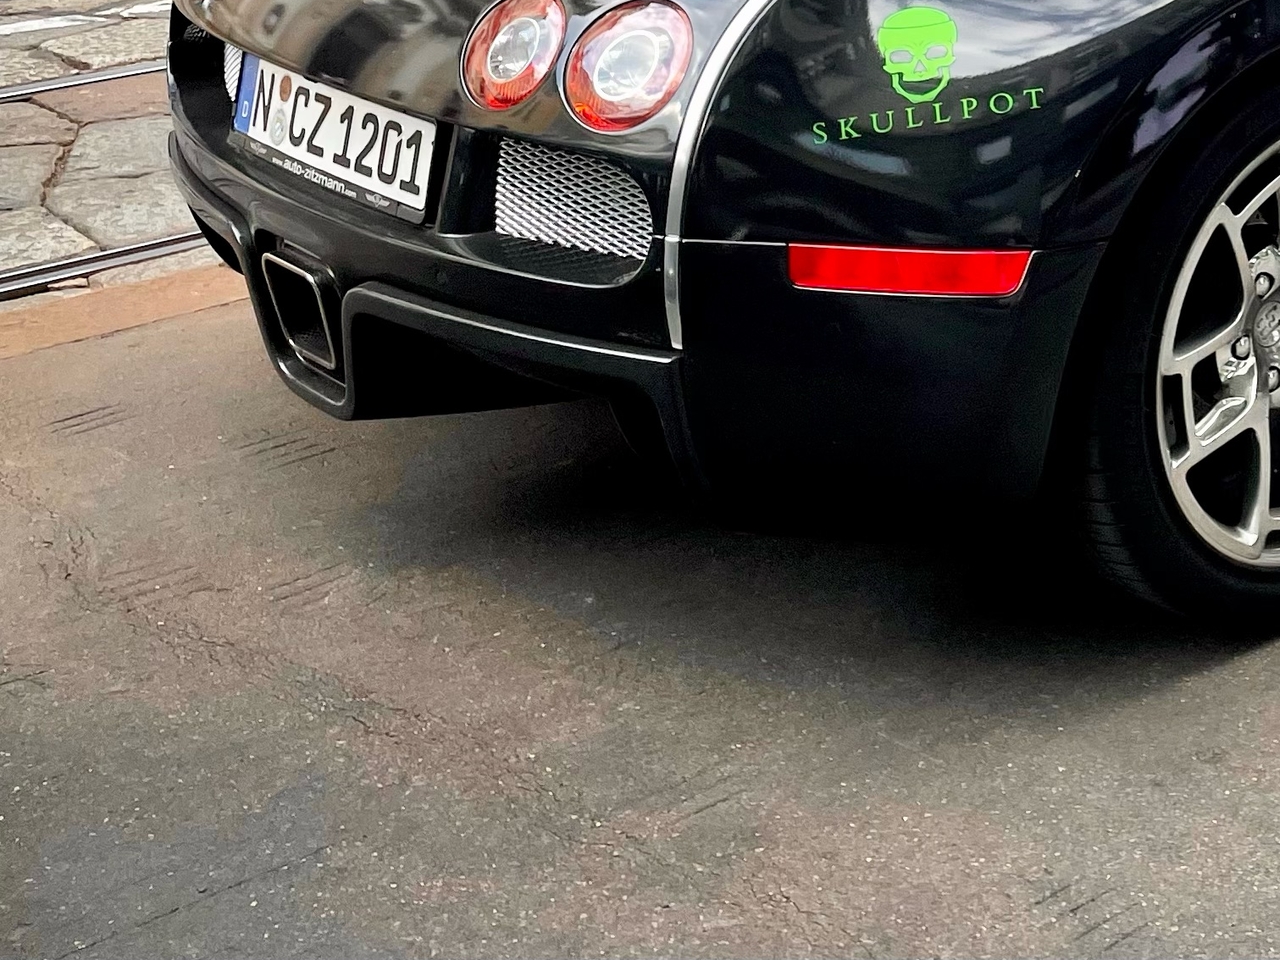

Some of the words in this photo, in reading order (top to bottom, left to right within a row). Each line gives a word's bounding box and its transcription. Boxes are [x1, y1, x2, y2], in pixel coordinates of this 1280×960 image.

[812, 88, 1044, 144] SKULLPOT
[272, 157, 357, 198] www.auto-zitzmann.com
[333, 105, 423, 196] 1201
